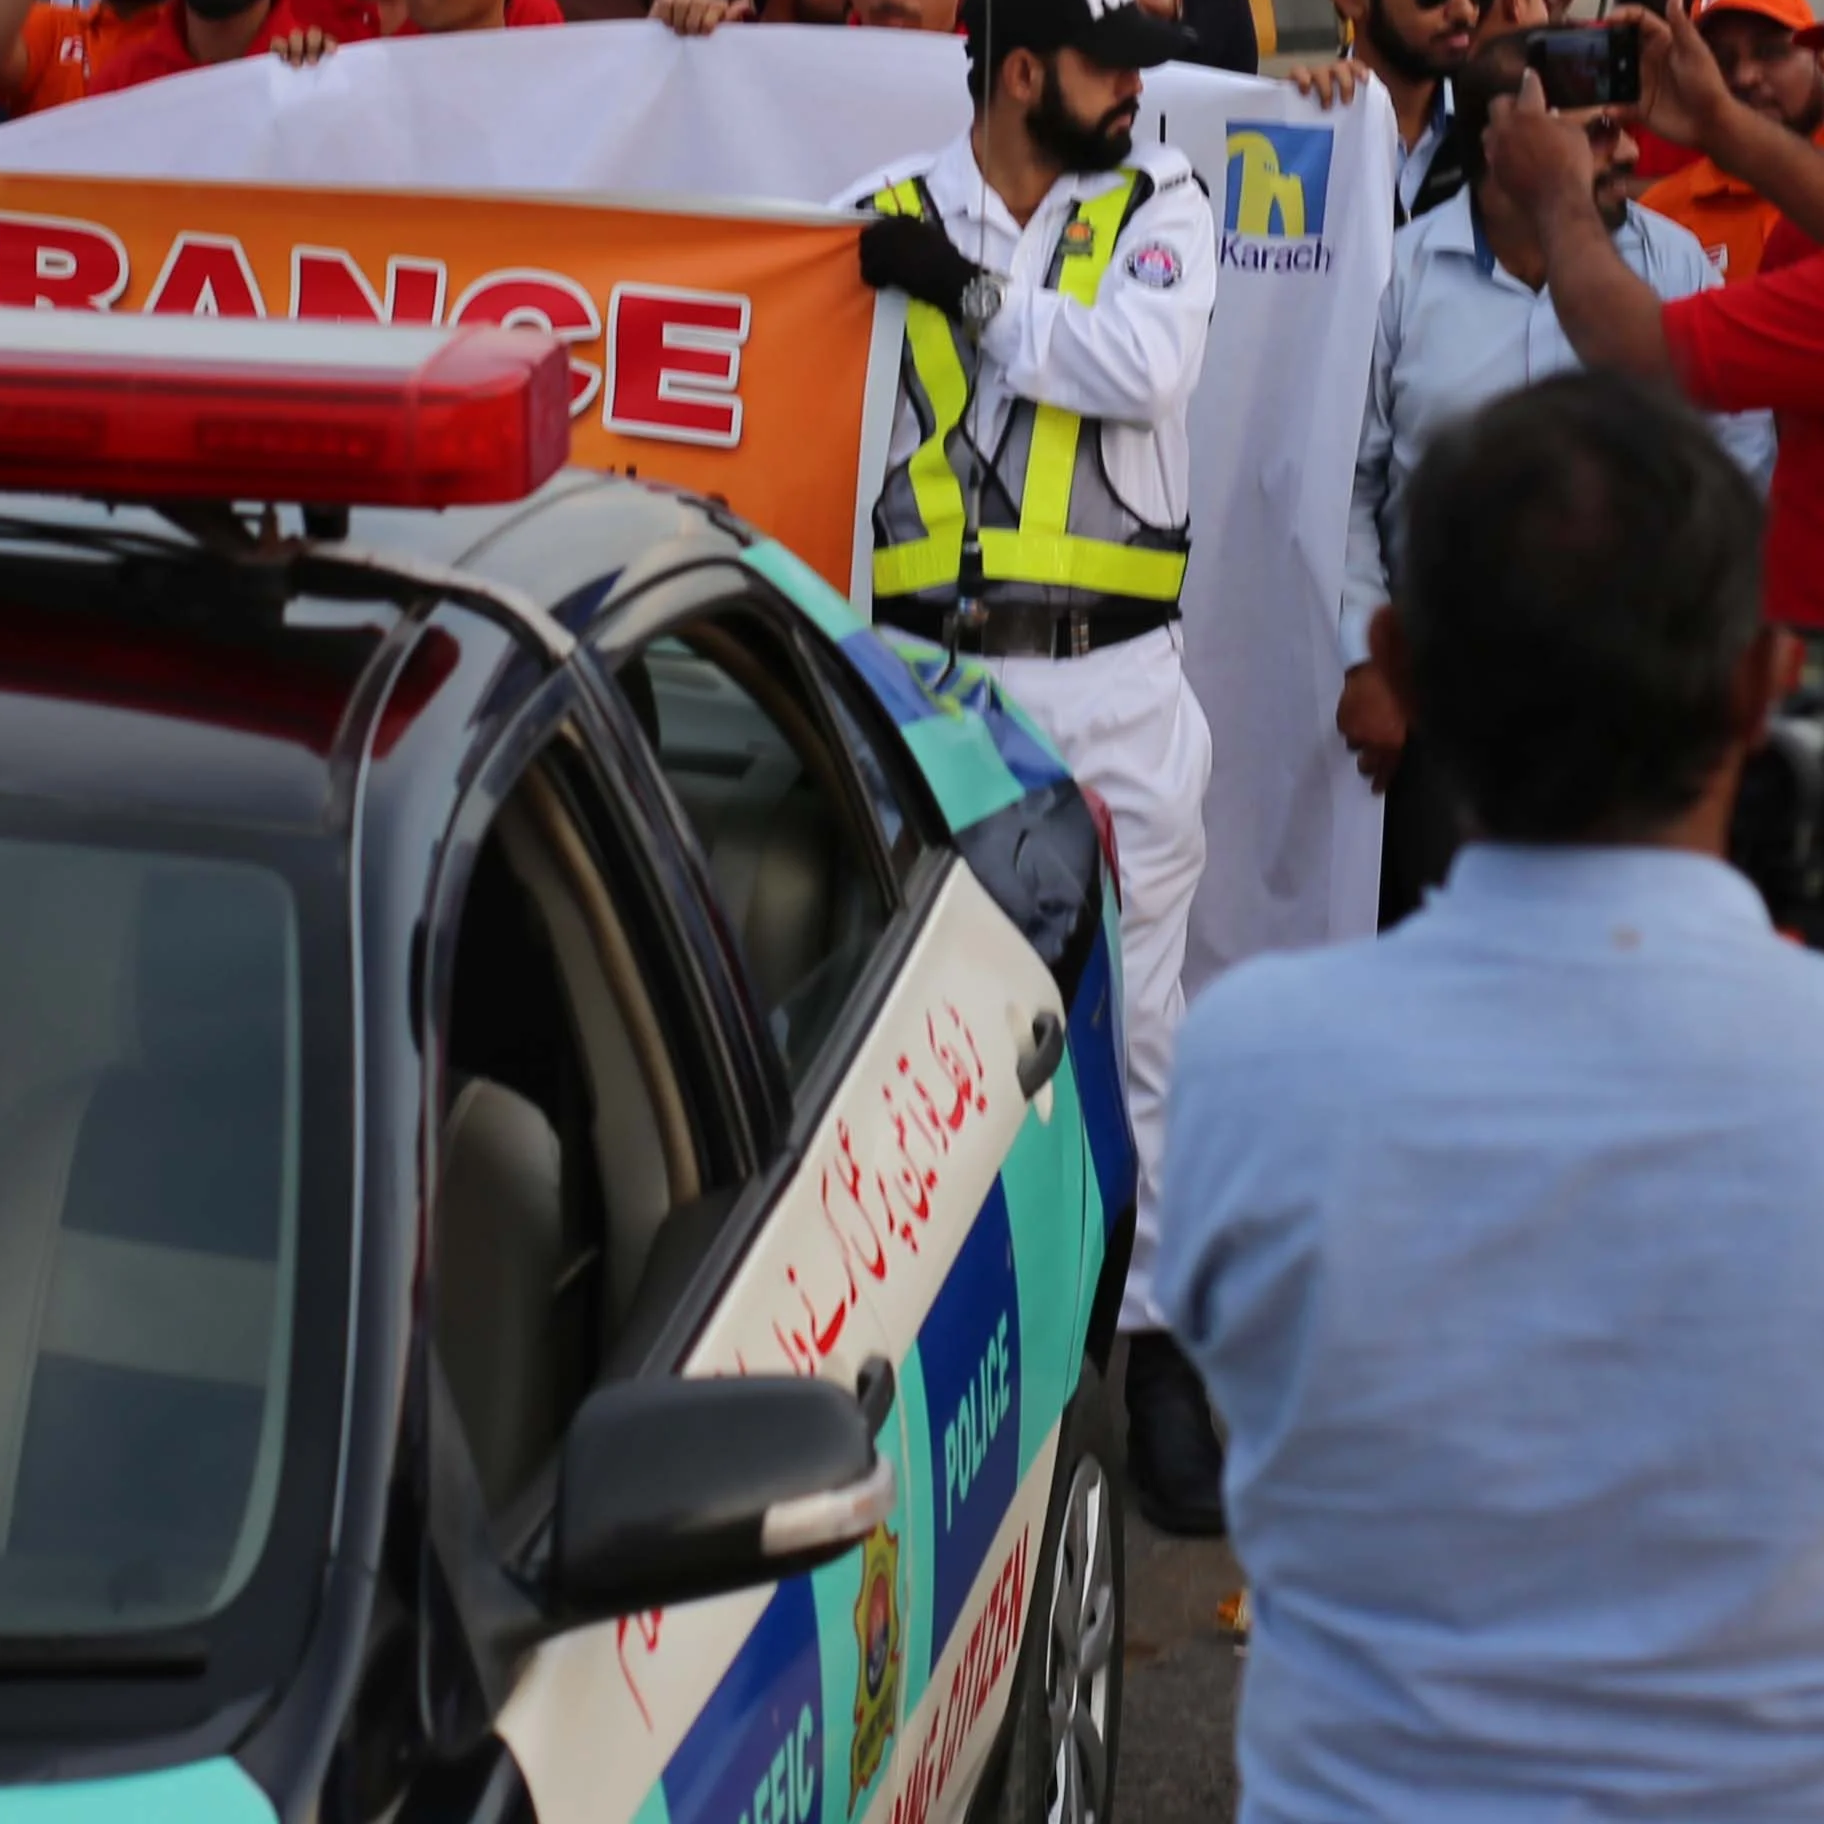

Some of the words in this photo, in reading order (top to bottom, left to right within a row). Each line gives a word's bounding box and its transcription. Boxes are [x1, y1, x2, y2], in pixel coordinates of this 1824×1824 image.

[1222, 235, 1332, 275] Karach
[943, 1308, 1011, 1534] POLICE
[935, 1521, 1030, 1801] CITIZEN
